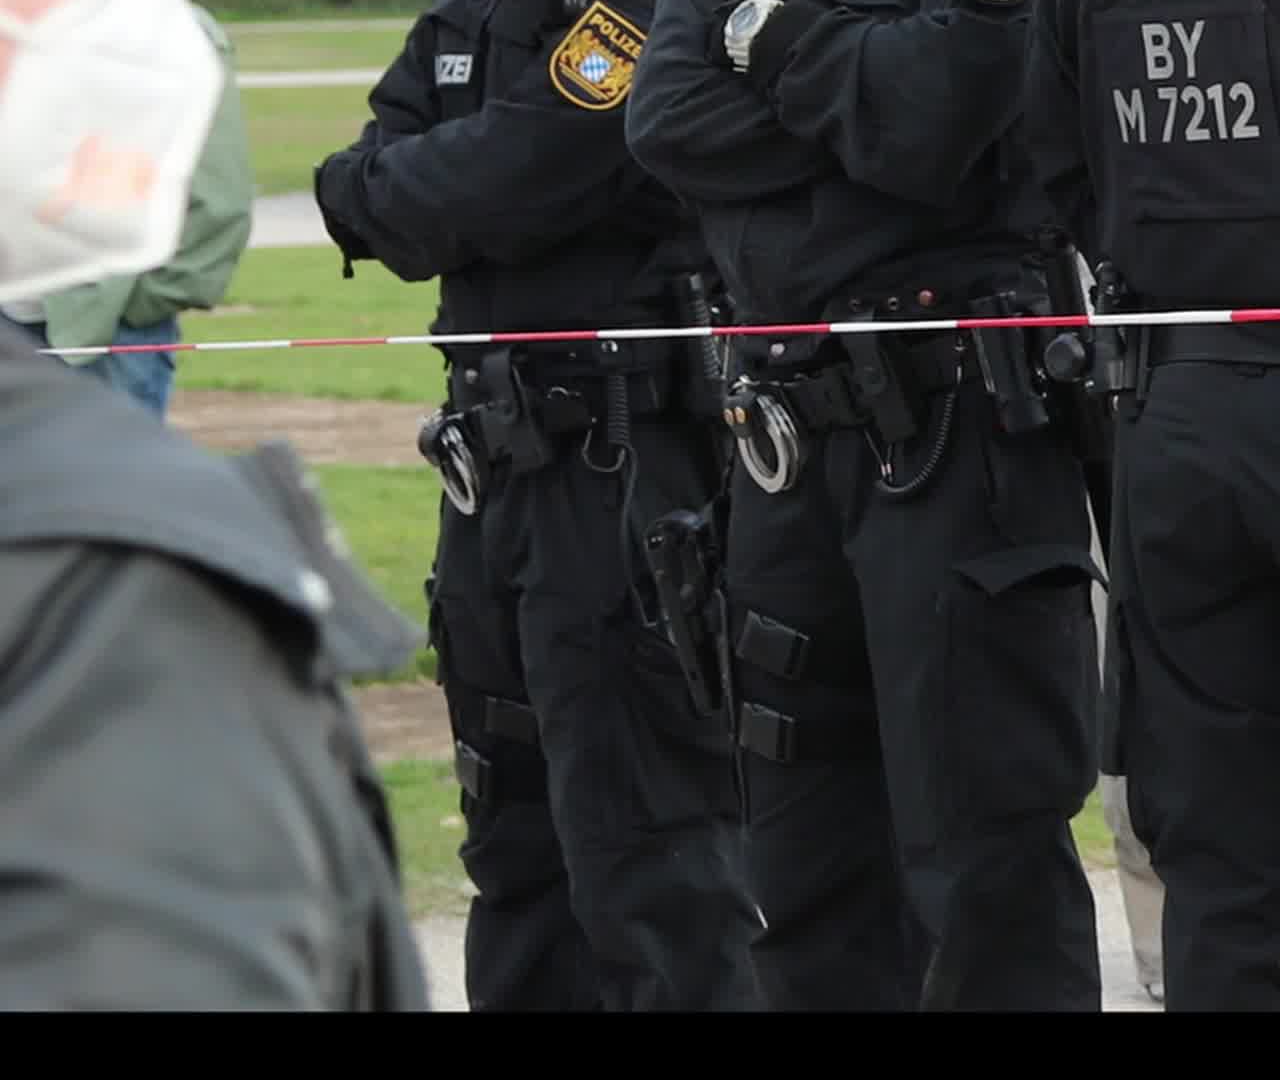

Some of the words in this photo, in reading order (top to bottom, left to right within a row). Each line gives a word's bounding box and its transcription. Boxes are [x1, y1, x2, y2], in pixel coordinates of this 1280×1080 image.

[1142, 21, 1204, 80] BY
[1113, 88, 1147, 143] M
[1157, 82, 1260, 143] 7212
